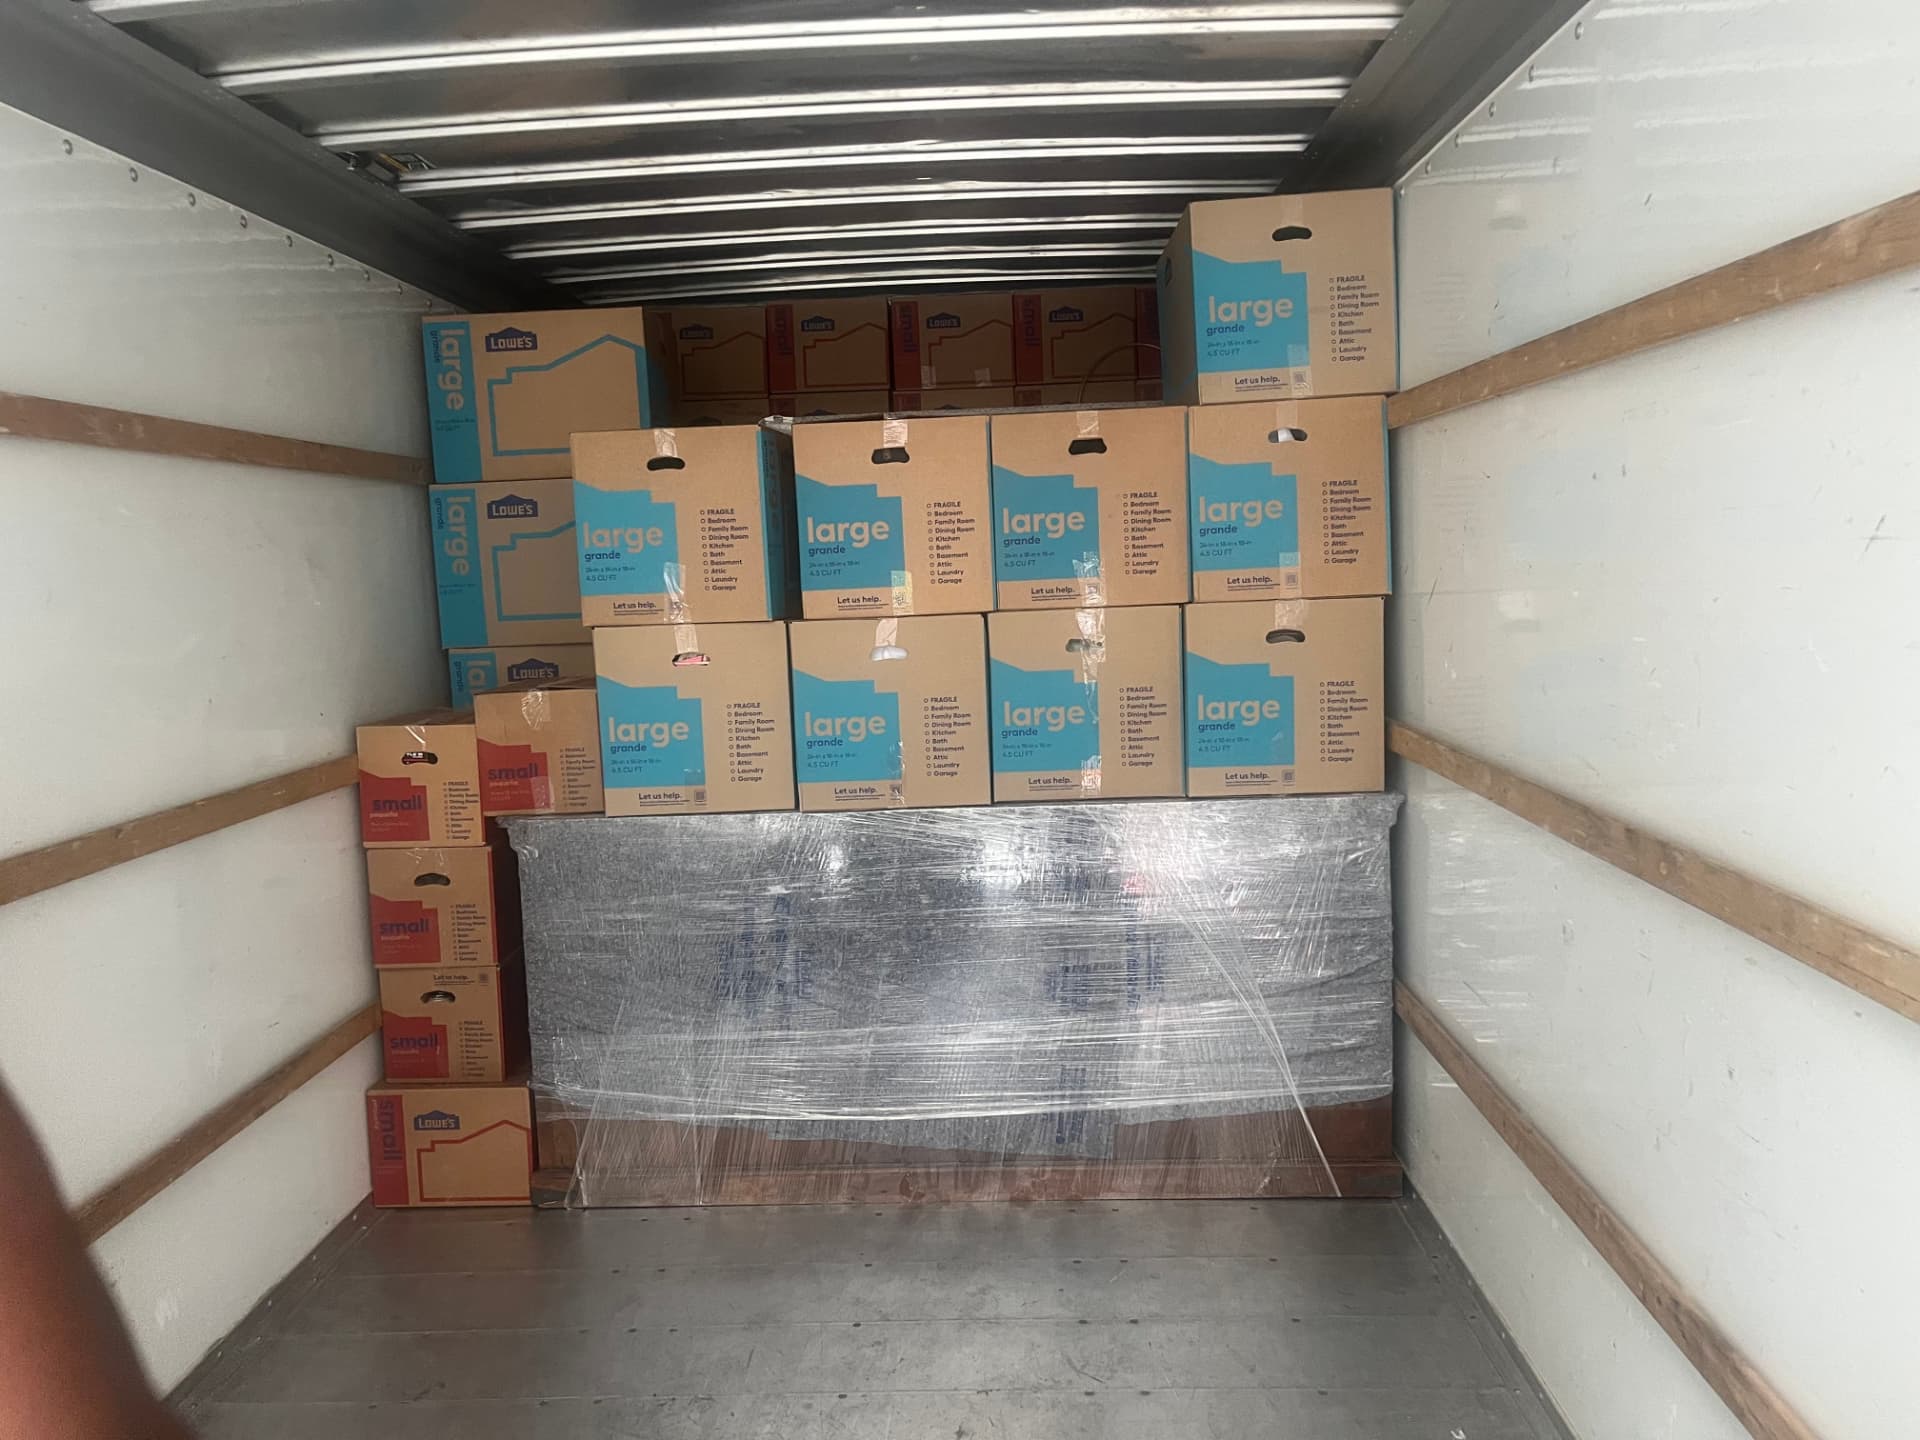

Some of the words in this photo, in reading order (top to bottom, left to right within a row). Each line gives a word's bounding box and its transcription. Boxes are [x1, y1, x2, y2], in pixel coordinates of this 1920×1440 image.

[1209, 295, 1293, 327] large
[1207, 325, 1244, 336] grande
[490, 336, 533, 349] LOWE'S
[438, 328, 464, 410] large
[1235, 377, 1248, 385] Let
[1261, 375, 1280, 384] help.
[492, 503, 533, 516] LOWE'S
[1199, 496, 1283, 527] large
[1003, 507, 1085, 539] large
[444, 496, 471, 576] large
[808, 517, 889, 548] large
[1200, 526, 1237, 536] grande
[583, 523, 663, 553] large
[1004, 537, 1040, 547] grande
[585, 551, 621, 562] grande
[809, 546, 846, 557] grande
[1253, 576, 1272, 584] help.
[1056, 586, 1074, 594] help.
[638, 601, 656, 609] help.
[862, 596, 881, 604] help.
[512, 666, 554, 680] LOWE'S
[1004, 702, 1085, 731] large
[1198, 696, 1280, 725] large
[609, 718, 689, 747] large
[805, 712, 886, 741] large
[1198, 722, 1235, 733] grande
[1002, 728, 1038, 739] grande
[610, 744, 647, 754] grande
[807, 738, 843, 749] grande
[488, 762, 538, 780] small
[1250, 772, 1269, 780] help.
[663, 792, 682, 800] help.
[372, 795, 422, 811] small
[379, 918, 429, 934] small
[391, 1032, 438, 1048] small
[379, 1100, 403, 1160] small
[418, 1118, 455, 1129] LOWE'S
